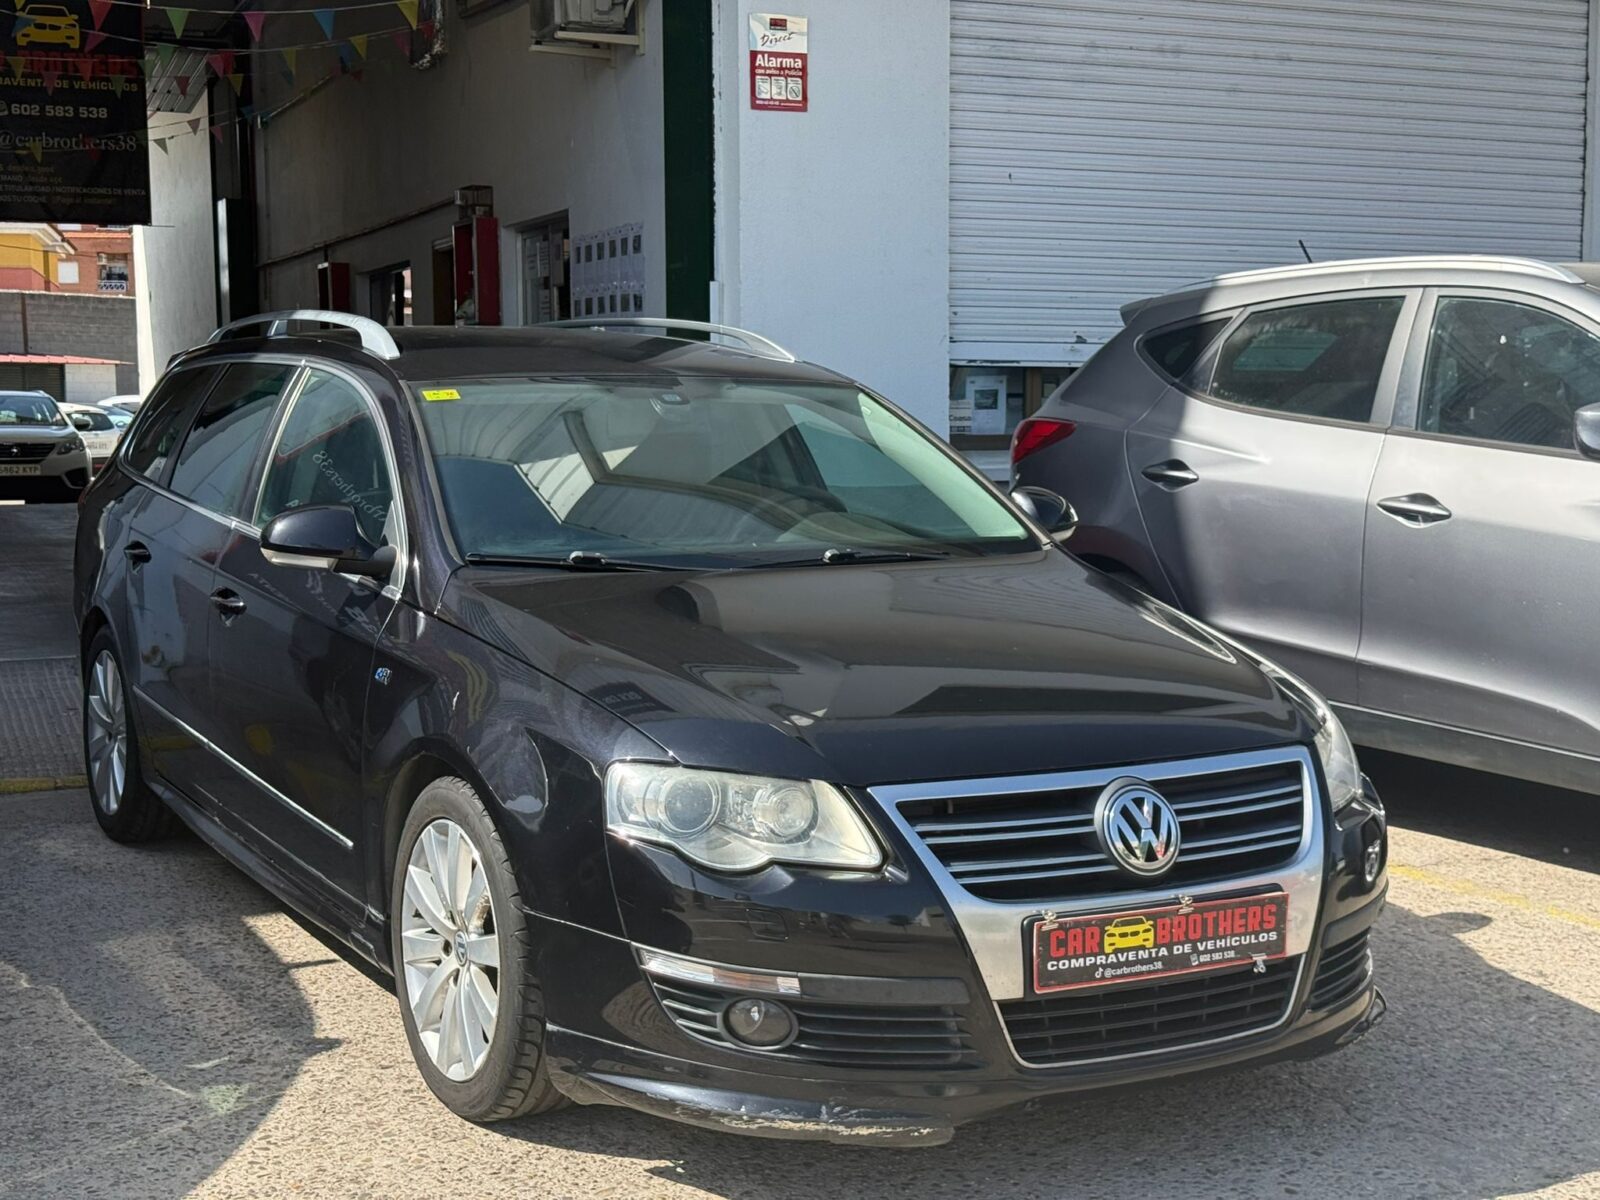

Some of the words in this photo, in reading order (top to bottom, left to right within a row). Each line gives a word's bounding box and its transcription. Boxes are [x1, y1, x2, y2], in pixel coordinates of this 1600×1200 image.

[755, 54, 803, 69] Alarma
[54, 80, 69, 88] DE
[73, 79, 138, 92] VEHÍCUOS
[11, 103, 40, 116] 602
[45, 105, 74, 117] 583
[79, 106, 108, 119] 538
[1049, 926, 1100, 958] CAR
[1156, 904, 1277, 945] BROTHERS
[1047, 946, 1169, 971] COMPRAVENTA
[1172, 943, 1193, 955] DE
[1196, 931, 1278, 951] VEHÍCULOS
[1104, 961, 1163, 978] @carbrothers38
